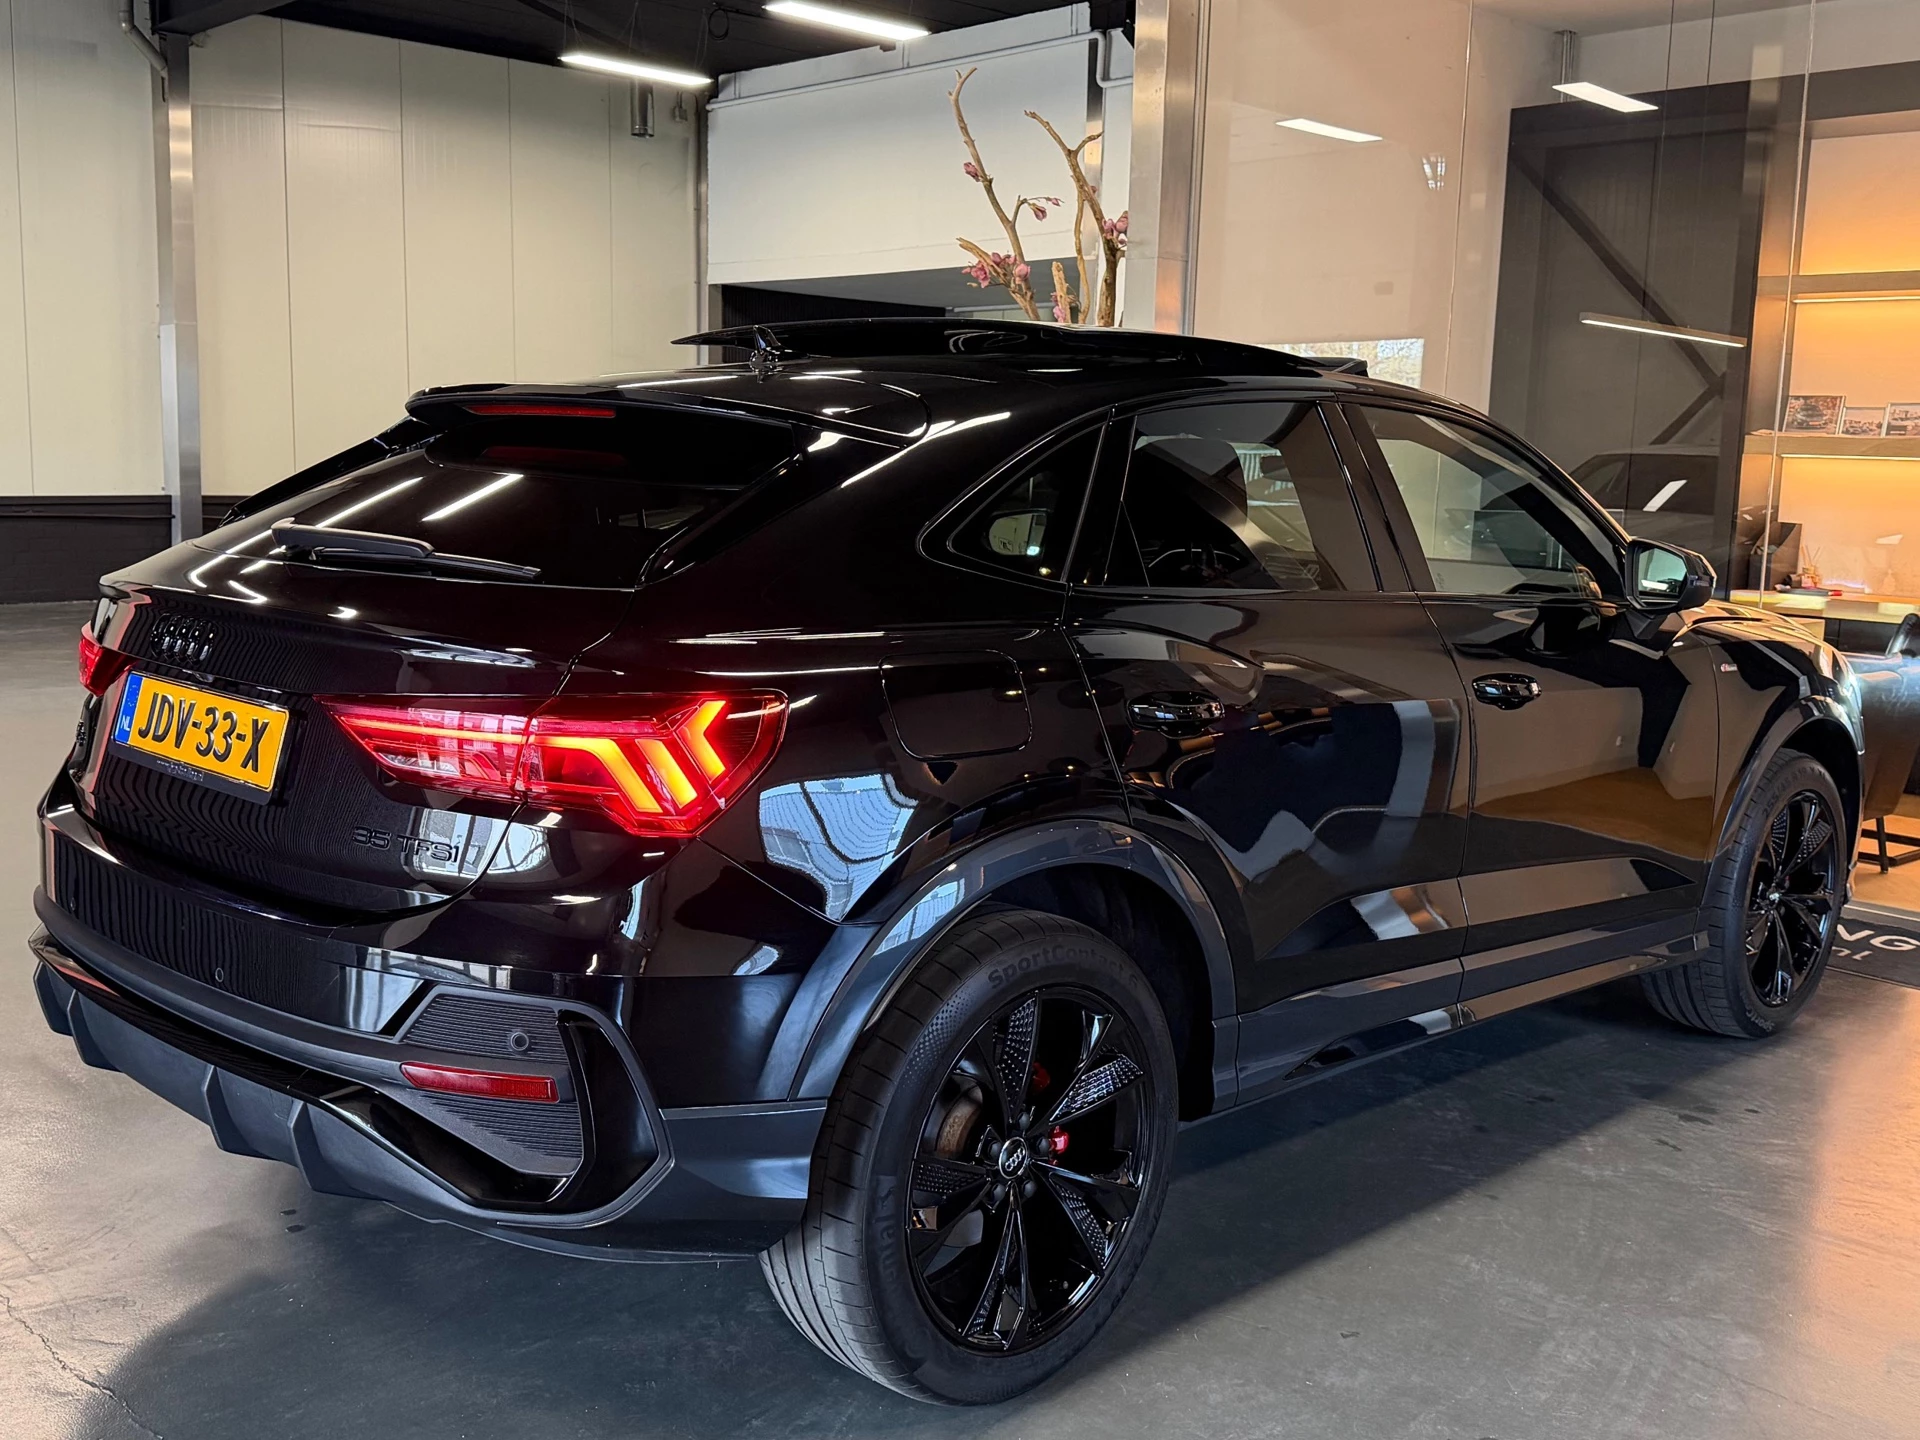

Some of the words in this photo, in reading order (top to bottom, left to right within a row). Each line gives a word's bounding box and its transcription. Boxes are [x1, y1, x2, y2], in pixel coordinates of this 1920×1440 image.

[119, 713, 131, 732] NL
[138, 691, 271, 773] JDV-33-X
[353, 826, 390, 851] 35
[396, 833, 460, 863] TFSI
